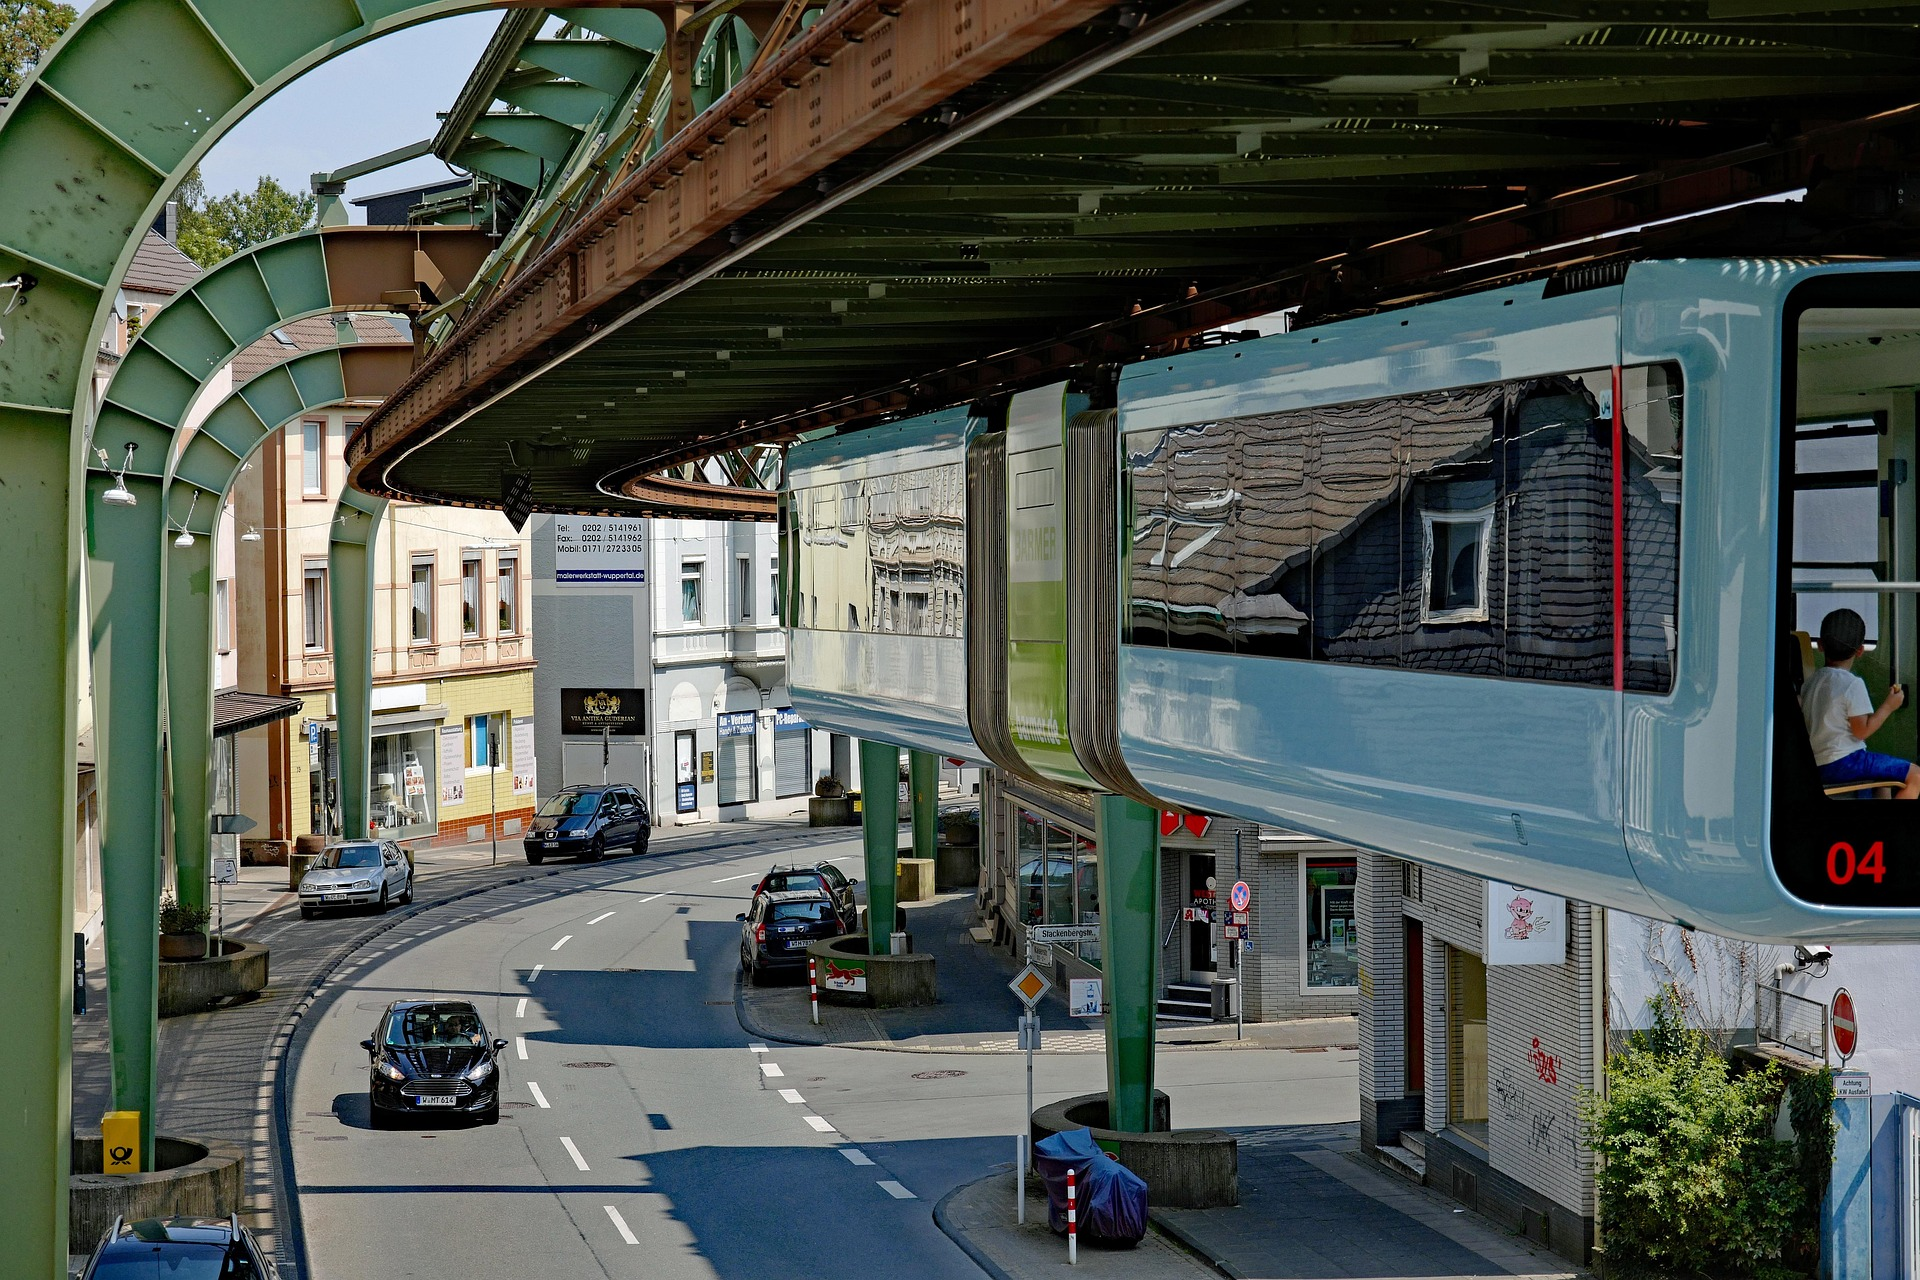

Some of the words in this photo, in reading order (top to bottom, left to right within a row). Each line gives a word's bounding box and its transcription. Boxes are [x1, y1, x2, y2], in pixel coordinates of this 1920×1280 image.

[557, 524, 570, 532] Tel:
[582, 524, 602, 532] 0202
[608, 524, 642, 532] 5141961
[557, 534, 573, 542] Fax:
[581, 534, 602, 542] 0202
[608, 534, 642, 542] 5141962
[1015, 526, 1056, 562] BARMER
[556, 572, 644, 580] malerwerkstatt-wuppertal.de
[730, 713, 752, 726] Verkauf
[1016, 704, 1061, 745] barmer.de
[1826, 841, 1886, 885] 04
